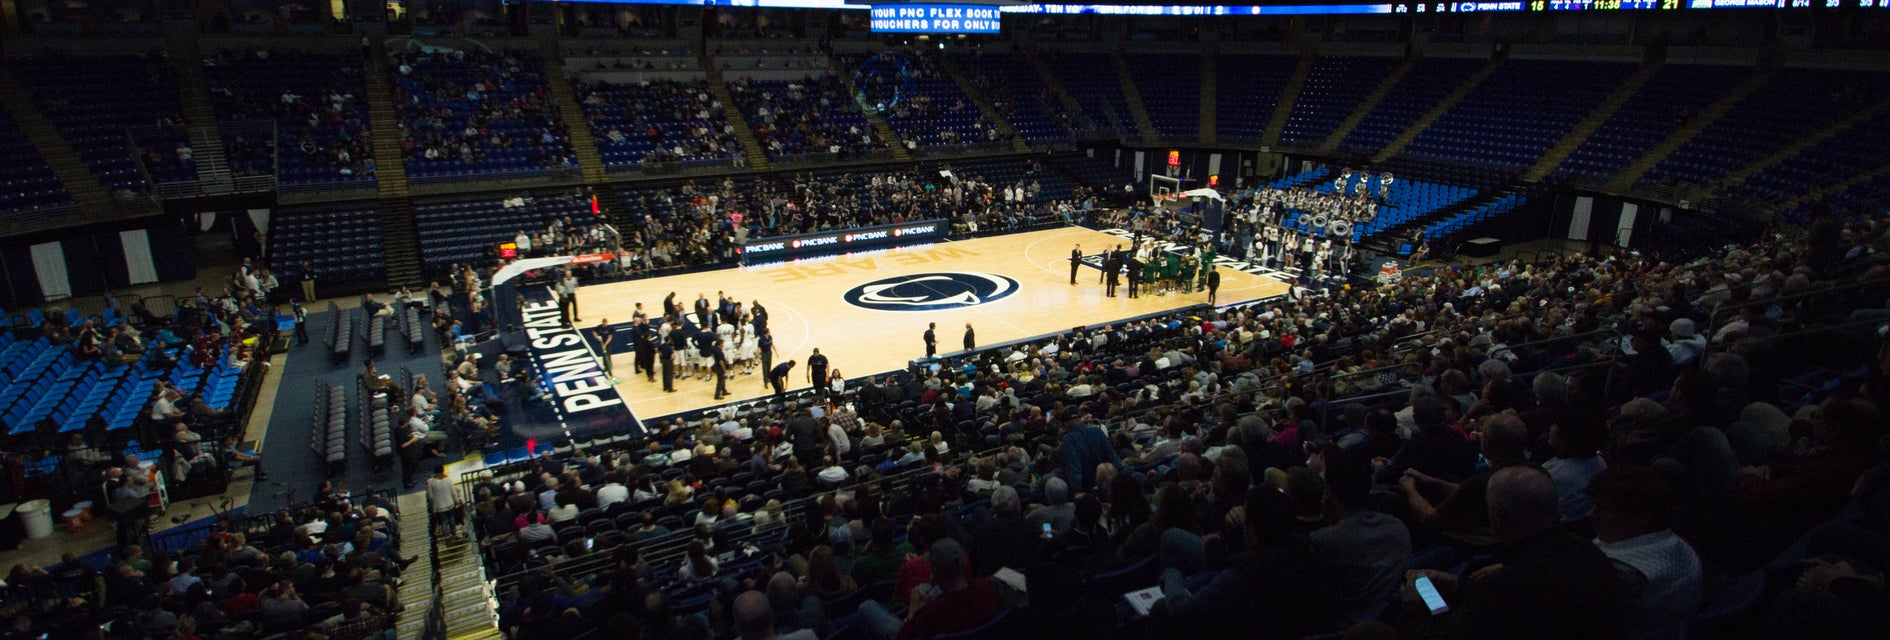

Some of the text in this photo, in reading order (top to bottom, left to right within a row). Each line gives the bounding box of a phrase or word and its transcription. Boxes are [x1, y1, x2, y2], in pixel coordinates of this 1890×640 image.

[1045, 4, 1063, 13] TEN
[1498, 2, 1521, 10] STATE
[1531, 1, 1544, 10] 15
[1663, 0, 1678, 9] 21
[874, 8, 895, 17] YOUR
[900, 8, 924, 17] PNC
[930, 8, 961, 18] FLEX
[966, 8, 992, 18] BOOK
[875, 20, 928, 29] VOUCHERS
[934, 20, 959, 29] FOR
[964, 20, 989, 30] ONLY
[522, 299, 621, 413] PENN STATE
